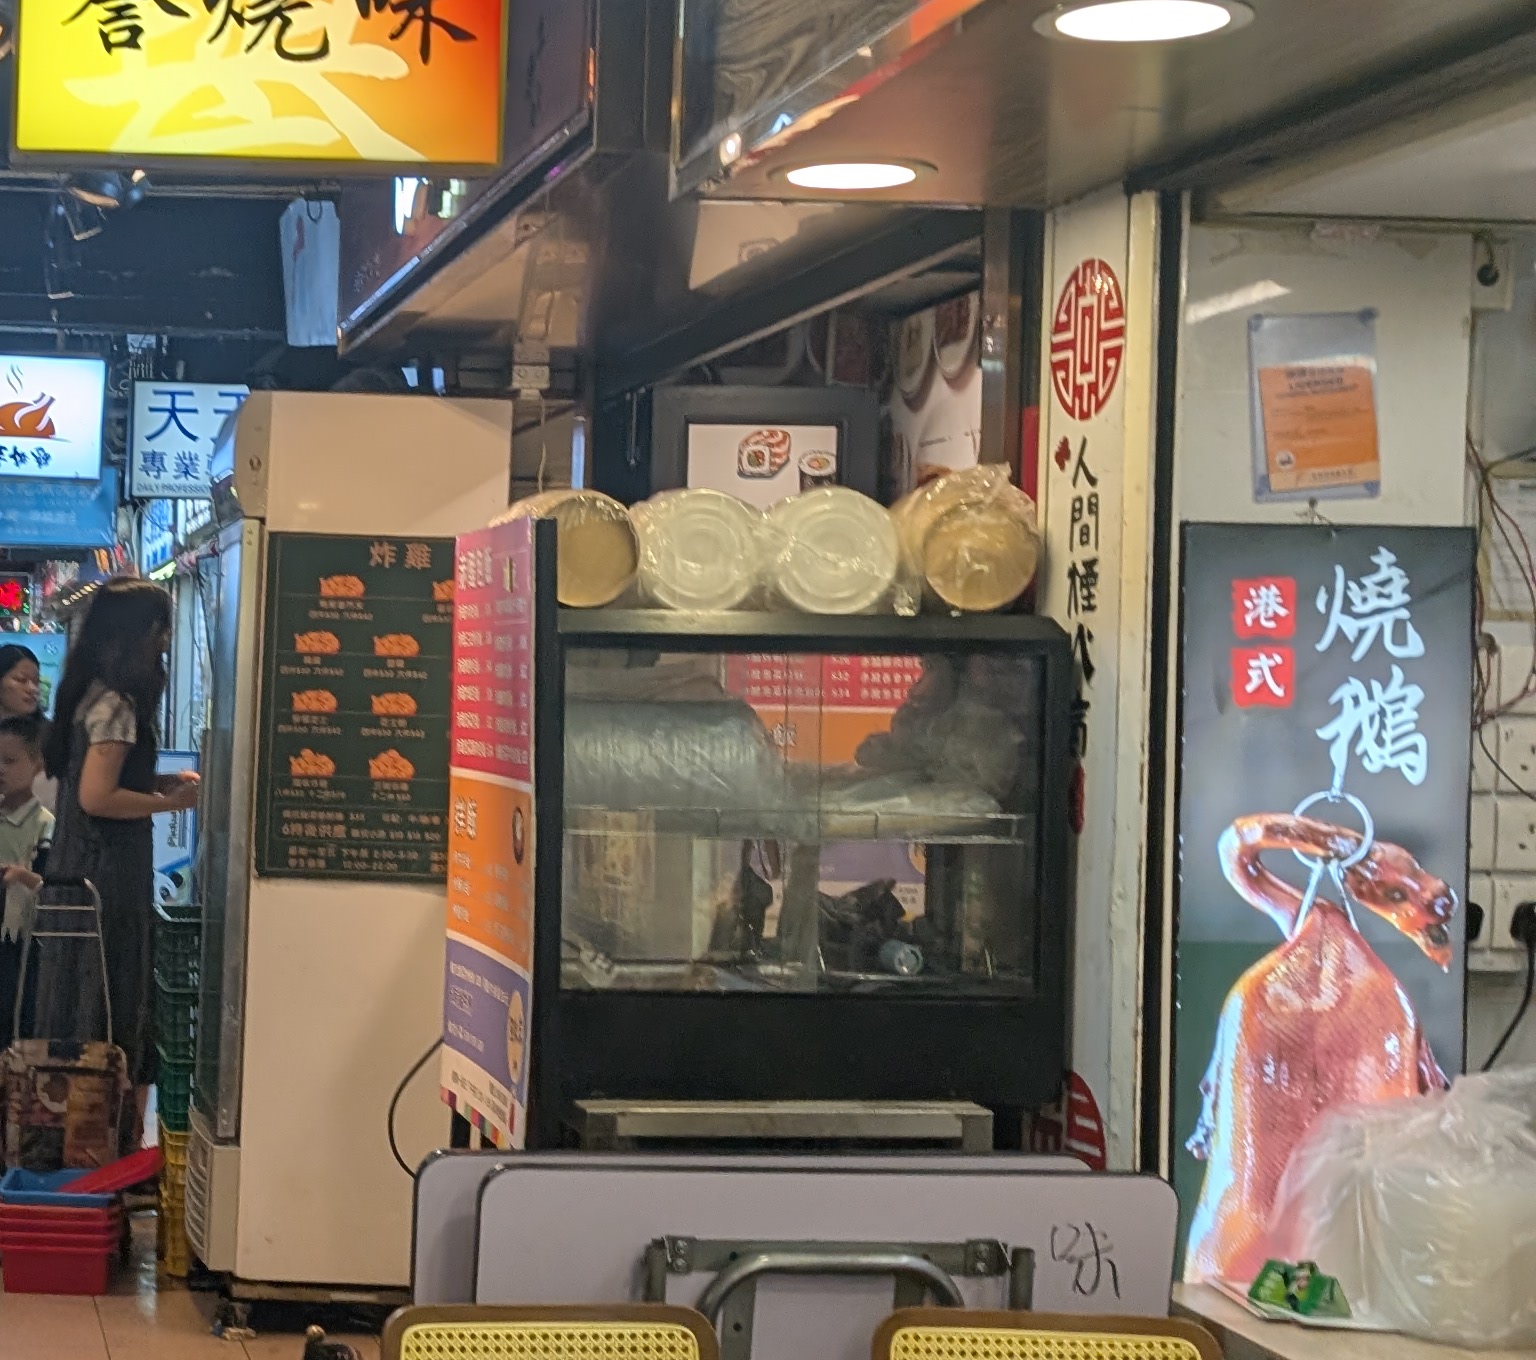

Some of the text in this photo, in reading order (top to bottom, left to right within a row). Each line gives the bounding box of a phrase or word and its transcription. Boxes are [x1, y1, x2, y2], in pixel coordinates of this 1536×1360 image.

[138, 449, 213, 481] 專業
[368, 541, 432, 570] 炸雞
[1243, 583, 1289, 698] 港式
[1314, 545, 1428, 791] 燒鵝
